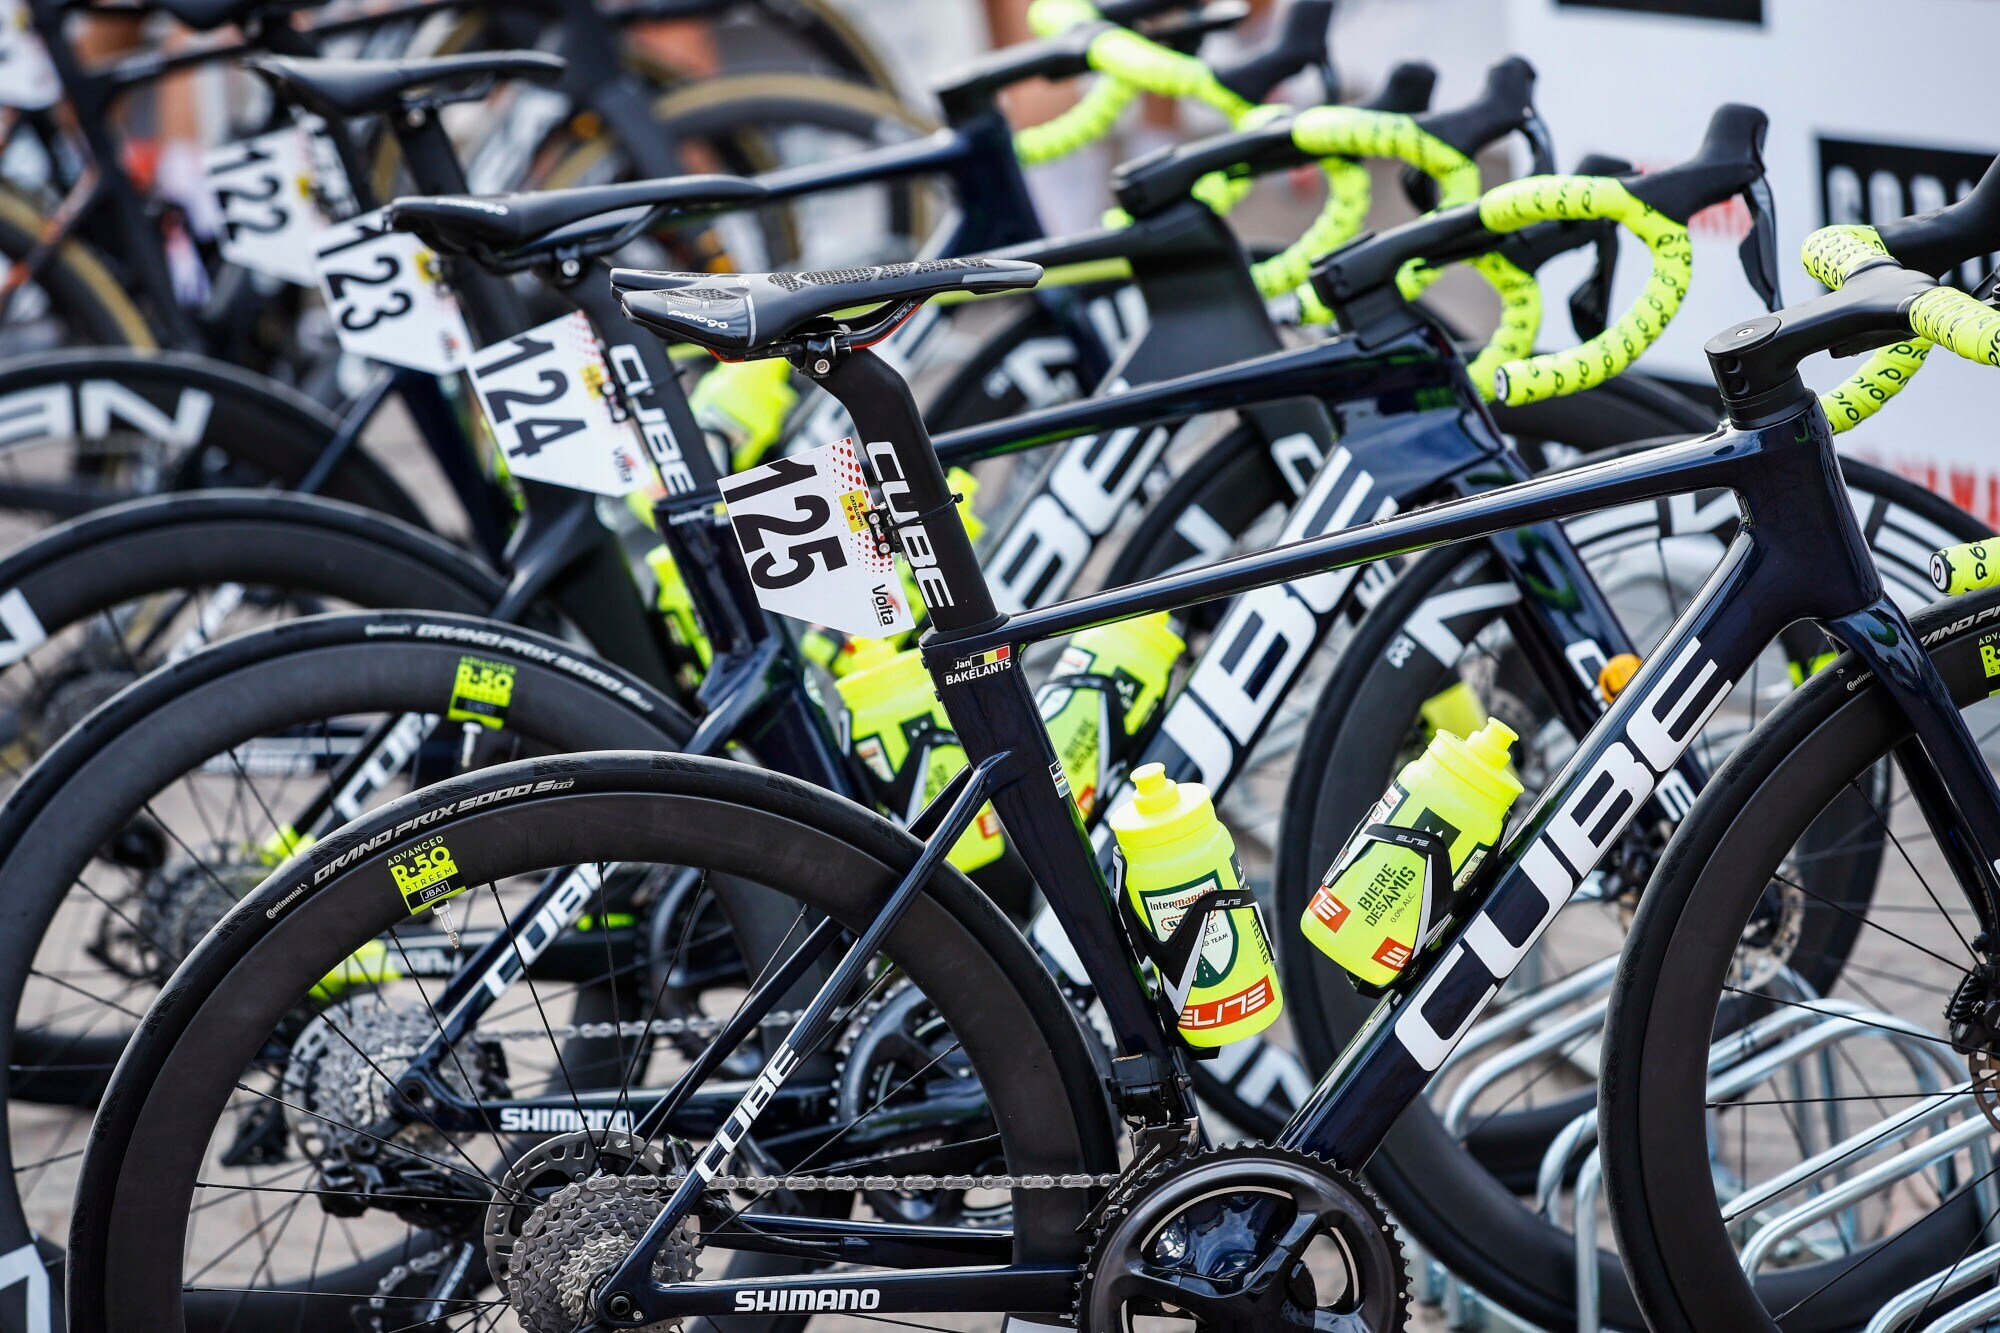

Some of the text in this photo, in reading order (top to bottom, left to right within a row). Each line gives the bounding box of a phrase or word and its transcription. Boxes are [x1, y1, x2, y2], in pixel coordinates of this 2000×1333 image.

[207, 146, 290, 244] 122
[317, 224, 413, 332] 123
[667, 309, 729, 330] prologo
[475, 337, 587, 459] 124
[609, 343, 697, 497] CUBE
[723, 458, 848, 590] 125
[849, 495, 864, 528] CATALUNYA
[866, 441, 955, 609] CUBE
[871, 584, 894, 626] Volta
[1919, 614, 1976, 647] AND
[415, 623, 500, 647] GRAND
[499, 637, 558, 663] PRIX
[554, 655, 625, 692] 5000
[945, 658, 1012, 685] BAKELANTS
[954, 660, 971, 670] Jan
[1846, 671, 1874, 691] Contine
[266, 886, 305, 919] Continental
[313, 829, 393, 886] GRAND
[395, 803, 456, 838] PRIX
[456, 783, 534, 813] 5000
[387, 835, 444, 867] ADVANCED
[1395, 636, 1733, 1072] CUBE
[405, 867, 453, 893] STREEM
[424, 885, 446, 899] JBA1
[1357, 863, 1397, 911] BIERE
[1211, 932, 1229, 945] TEAM
[1179, 983, 1266, 1027] ELITE
[500, 1107, 636, 1132] SHIMANO
[696, 1043, 799, 1183] CUBE
[1108, 1143, 1161, 1200] DURA-ACE
[734, 1288, 880, 1312] SHIMANO
